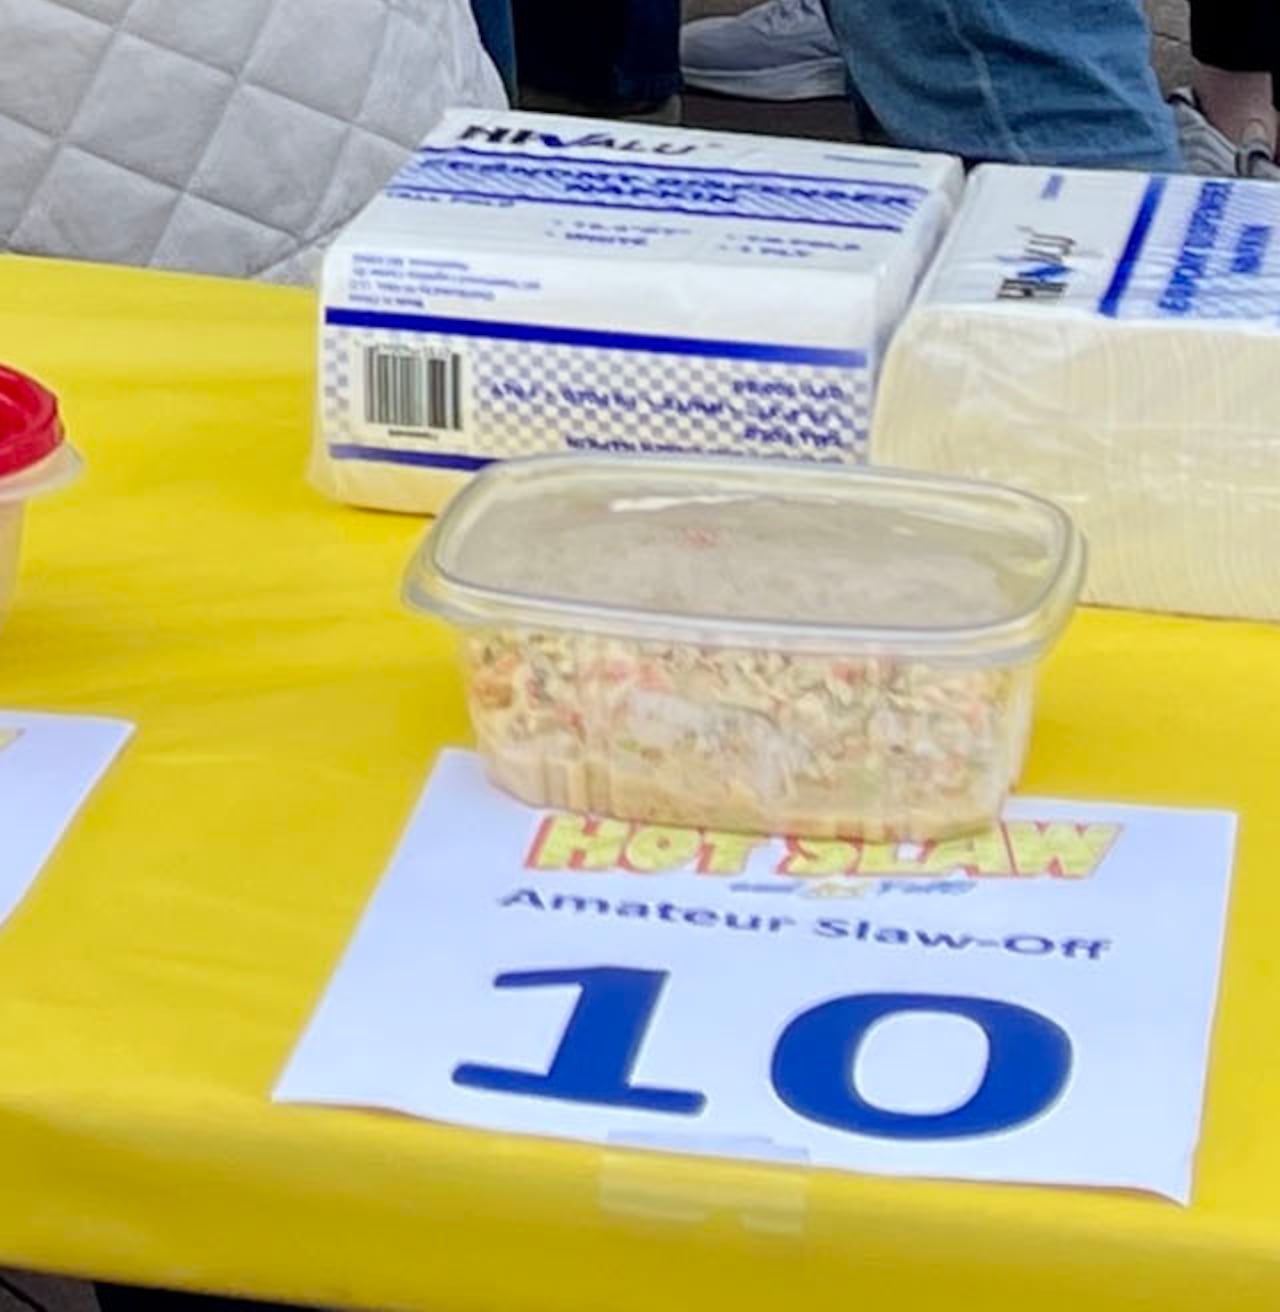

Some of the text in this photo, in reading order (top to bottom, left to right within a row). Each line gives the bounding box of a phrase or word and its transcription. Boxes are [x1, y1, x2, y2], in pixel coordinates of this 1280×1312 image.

[523, 814, 1128, 879] HOT SLAW
[495, 886, 1114, 962] Amateur Slaw-Off
[450, 963, 1075, 1143] 10
